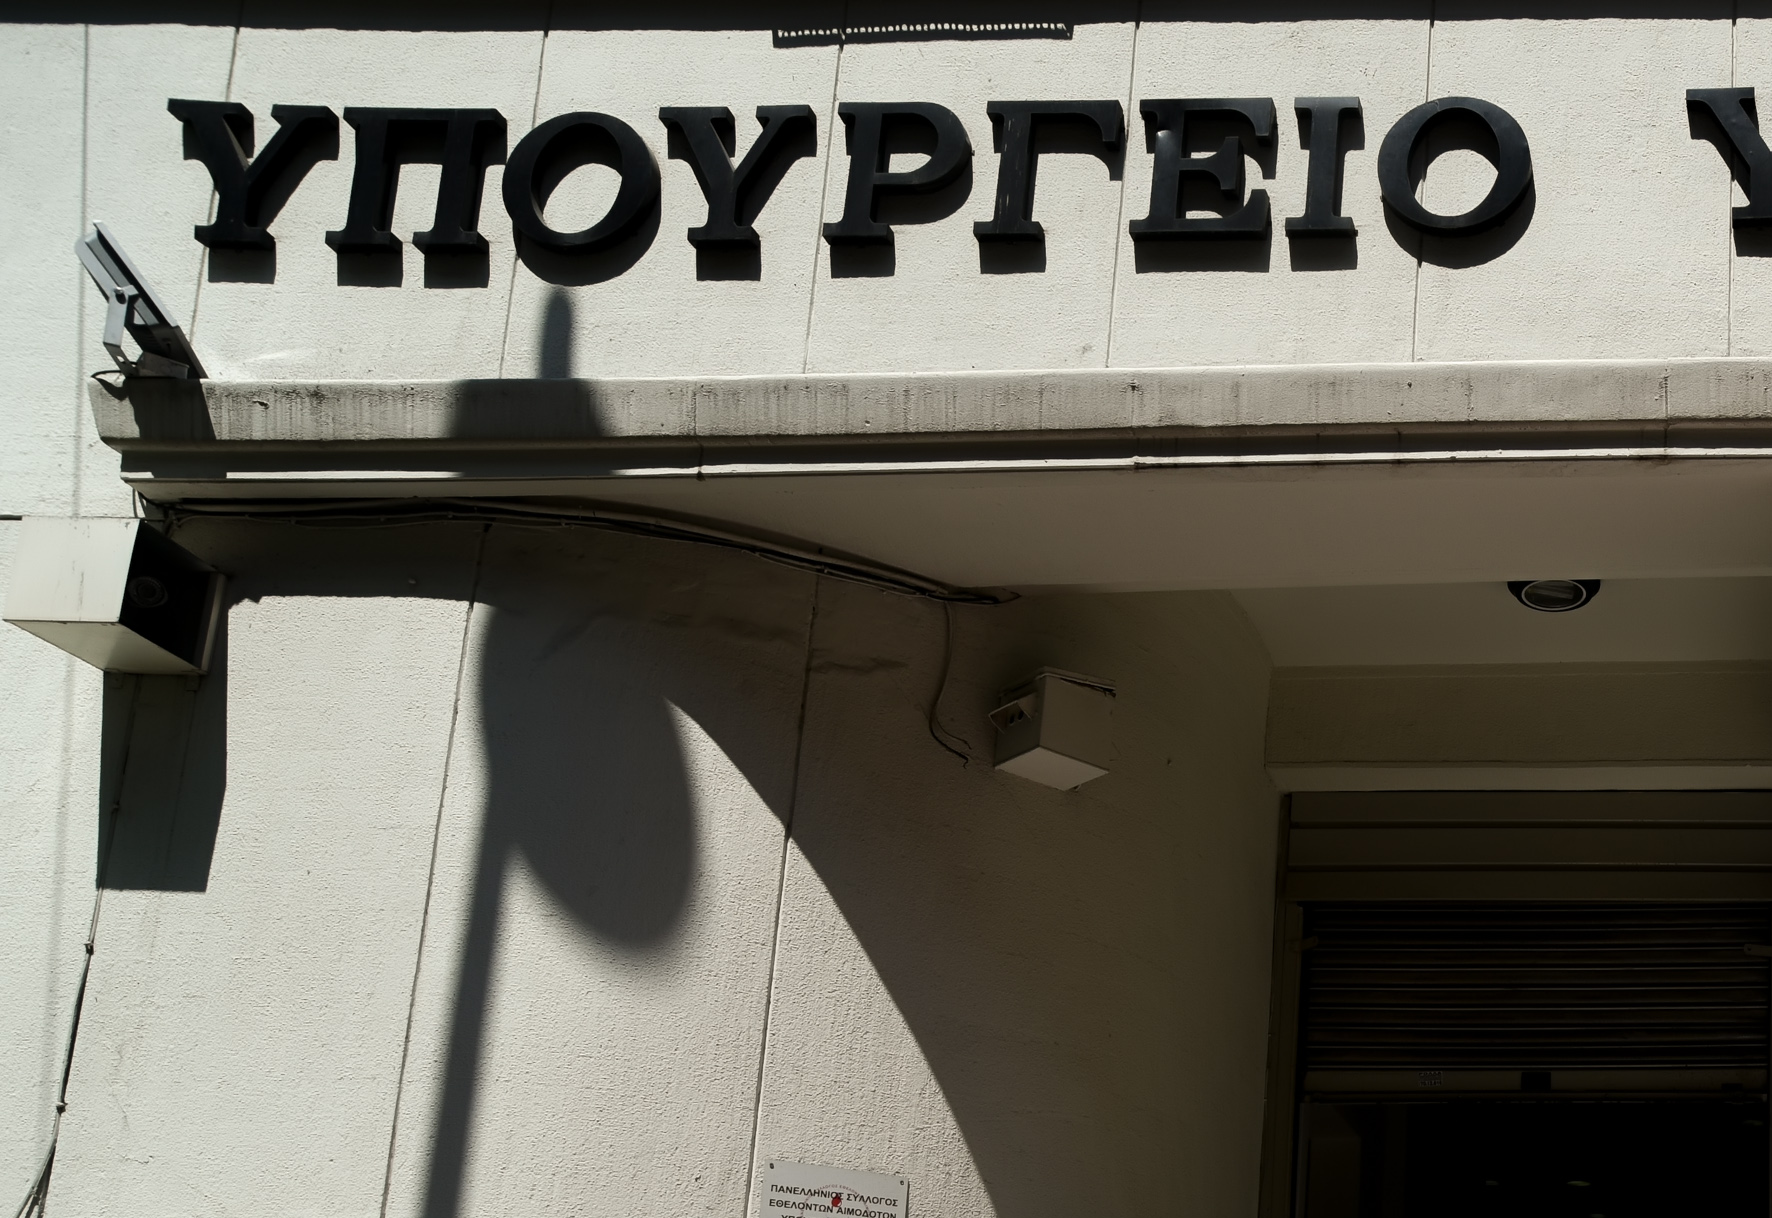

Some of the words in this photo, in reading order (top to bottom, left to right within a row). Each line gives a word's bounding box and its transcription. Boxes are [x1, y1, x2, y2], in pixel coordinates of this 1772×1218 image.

[167, 96, 1536, 256] ΥΠΟΥΡΓΕΙΟ
[769, 1199, 834, 1213] ΕΘΕΛΟΝΤΩΝ
[770, 1184, 844, 1200] ΠΑΝΕΛΛΗΝΙΟΣ
[846, 1193, 899, 1207] ΣΥΛΛΟΓΟΣ
